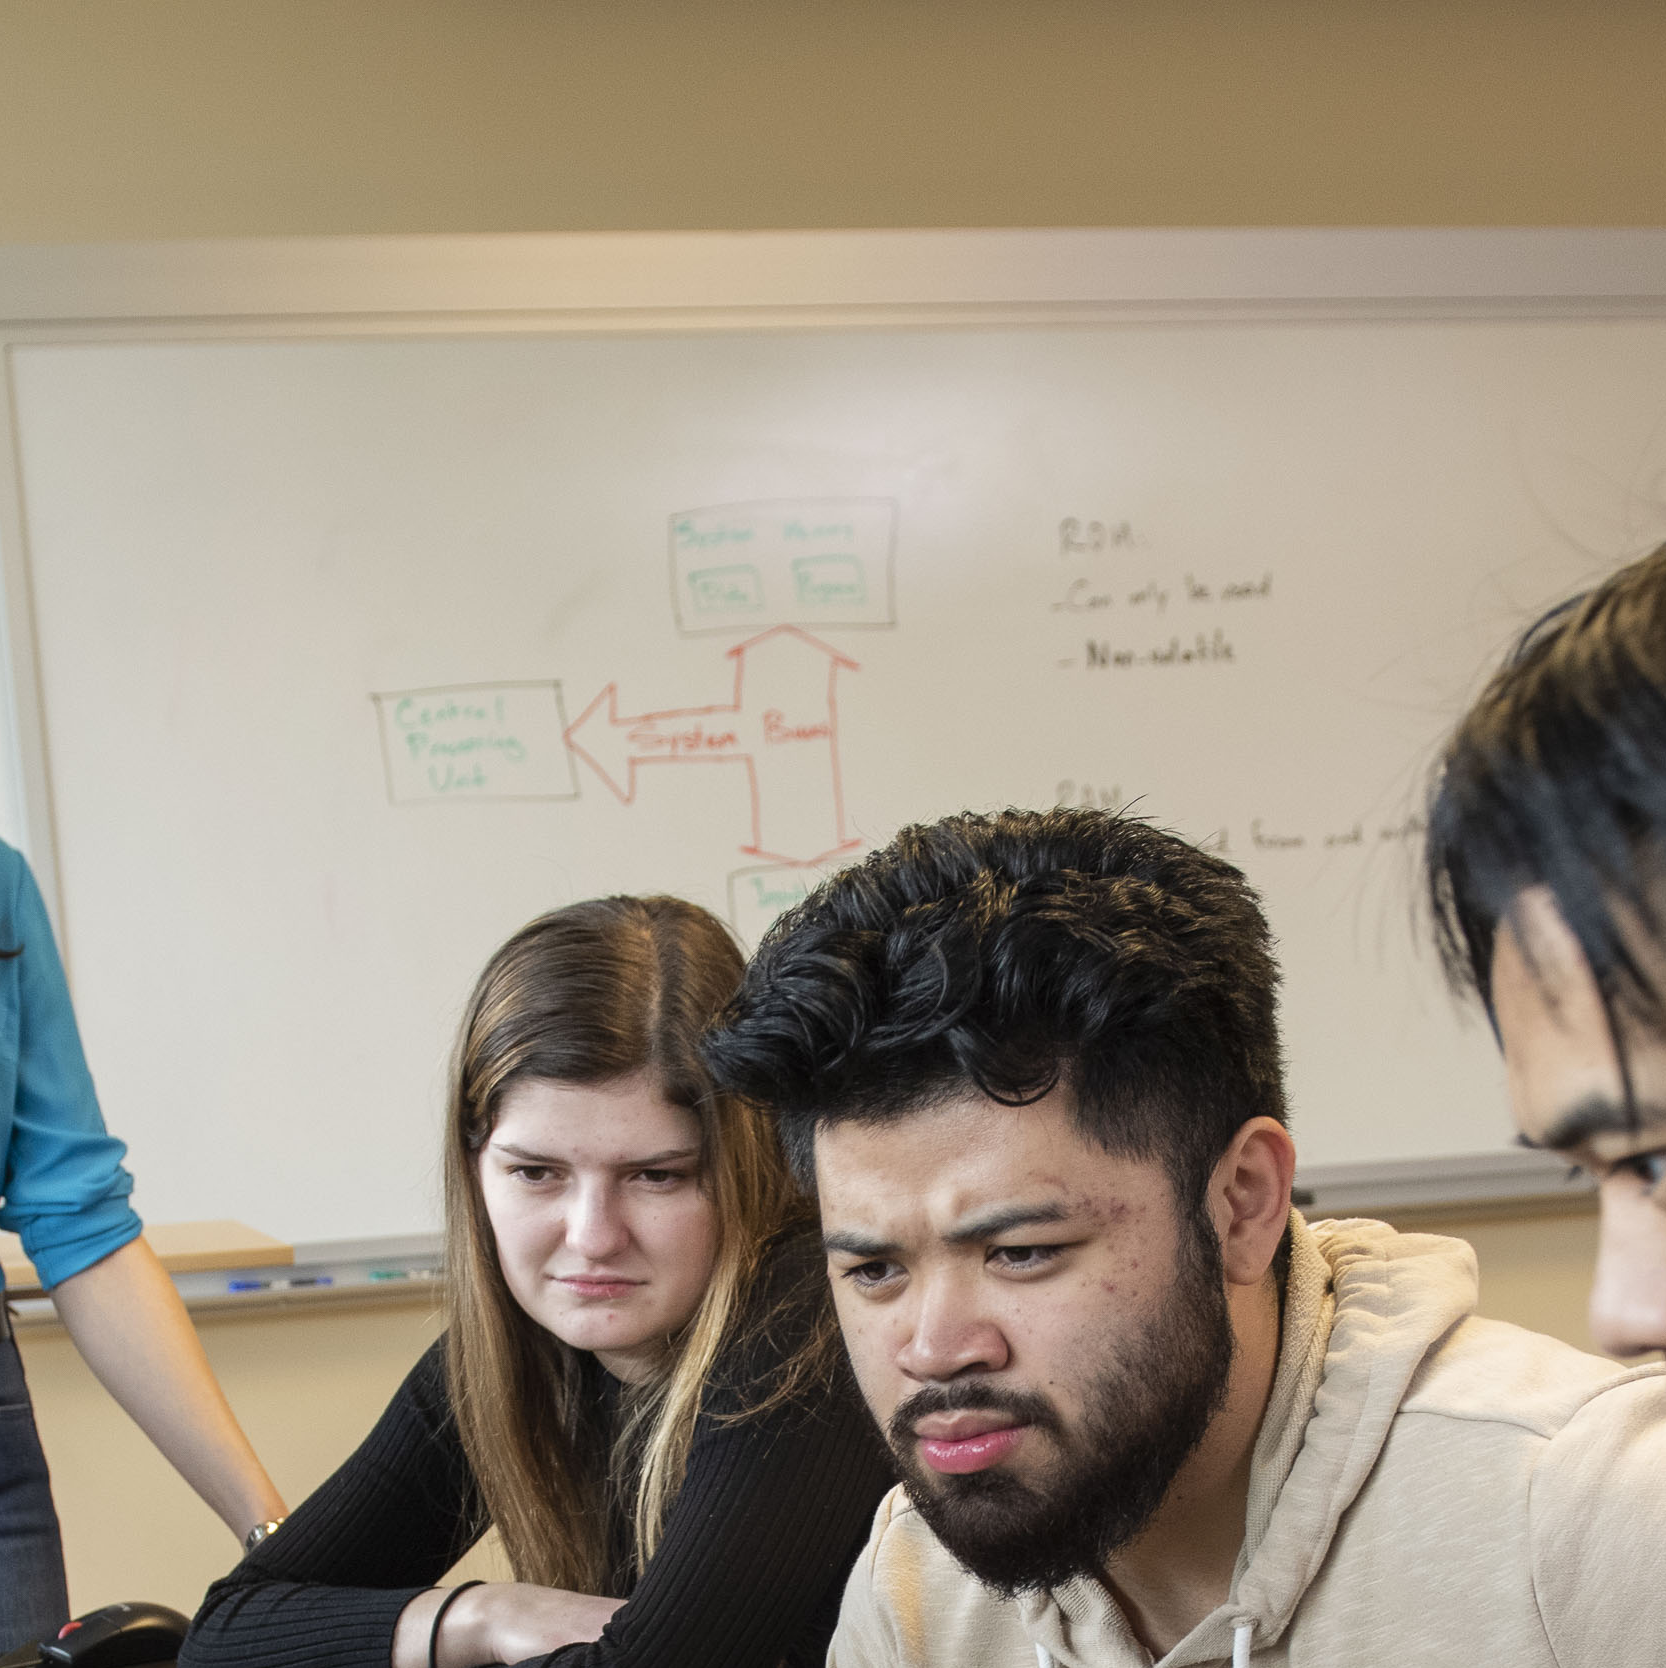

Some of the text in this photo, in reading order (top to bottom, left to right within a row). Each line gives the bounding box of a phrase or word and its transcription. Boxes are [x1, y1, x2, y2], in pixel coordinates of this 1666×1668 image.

[394, 696, 506, 731] Central
[406, 731, 528, 763] Processing
[627, 721, 738, 757] System
[427, 763, 488, 792] Unit
